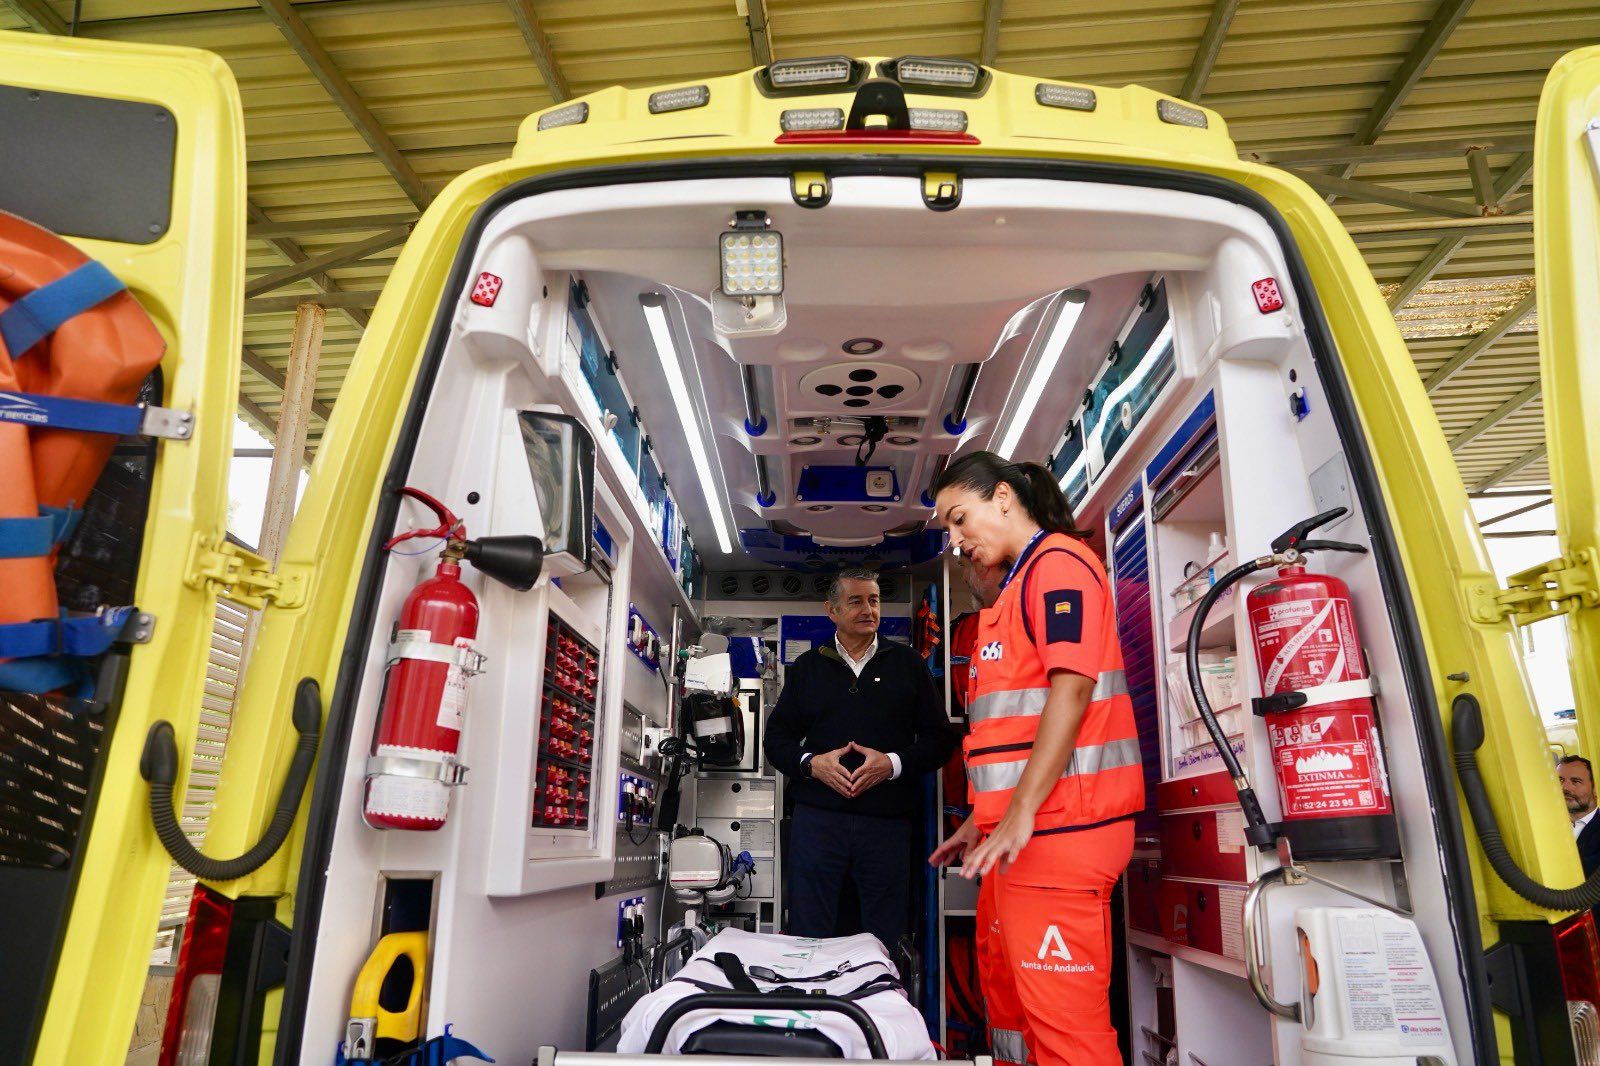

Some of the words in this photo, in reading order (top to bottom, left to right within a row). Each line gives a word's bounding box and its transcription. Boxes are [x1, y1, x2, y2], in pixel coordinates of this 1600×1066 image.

[1277, 604, 1311, 616] profuego
[980, 641, 1003, 661] 061
[1298, 771, 1345, 783] EXTINMA
[1316, 800, 1327, 808] 24
[1329, 799, 1341, 808] 23
[1021, 960, 1041, 971] Junta
[1054, 962, 1095, 972] Andalucía
